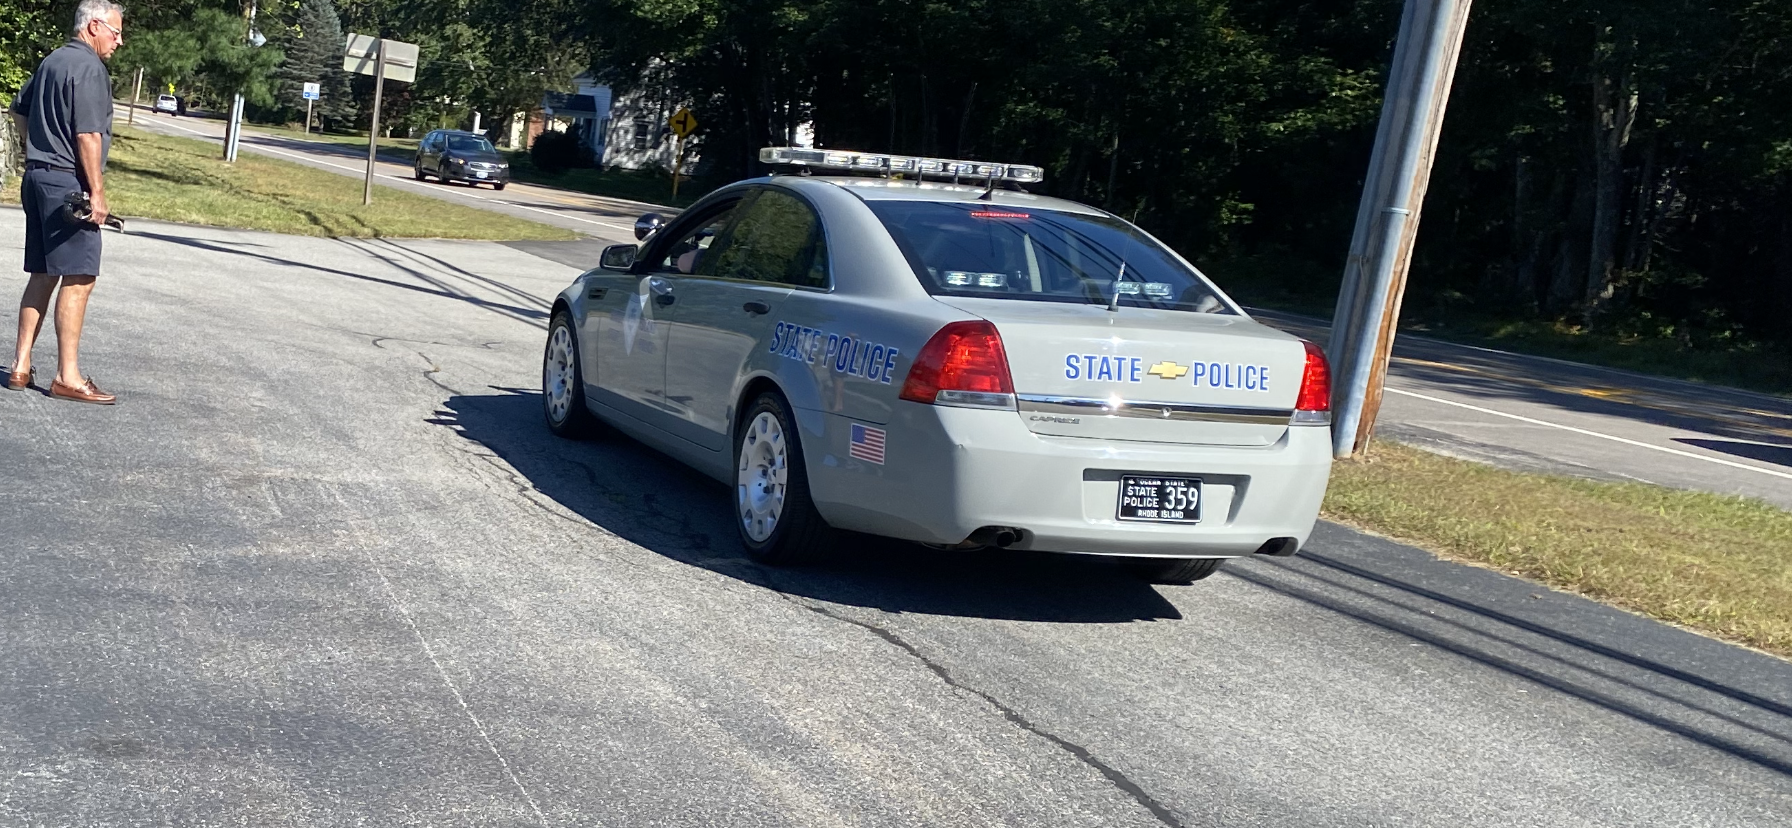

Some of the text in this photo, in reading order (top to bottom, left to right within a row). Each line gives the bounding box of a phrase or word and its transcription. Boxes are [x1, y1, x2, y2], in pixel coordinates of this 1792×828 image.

[769, 321, 899, 385] STATE POLICE
[1065, 354, 1270, 391] STATE POLICE
[1127, 486, 1158, 497] STATE
[1164, 487, 1198, 510] 359
[1123, 496, 1159, 508] POLICE
[1137, 509, 1184, 519] RHODE ISLAND
